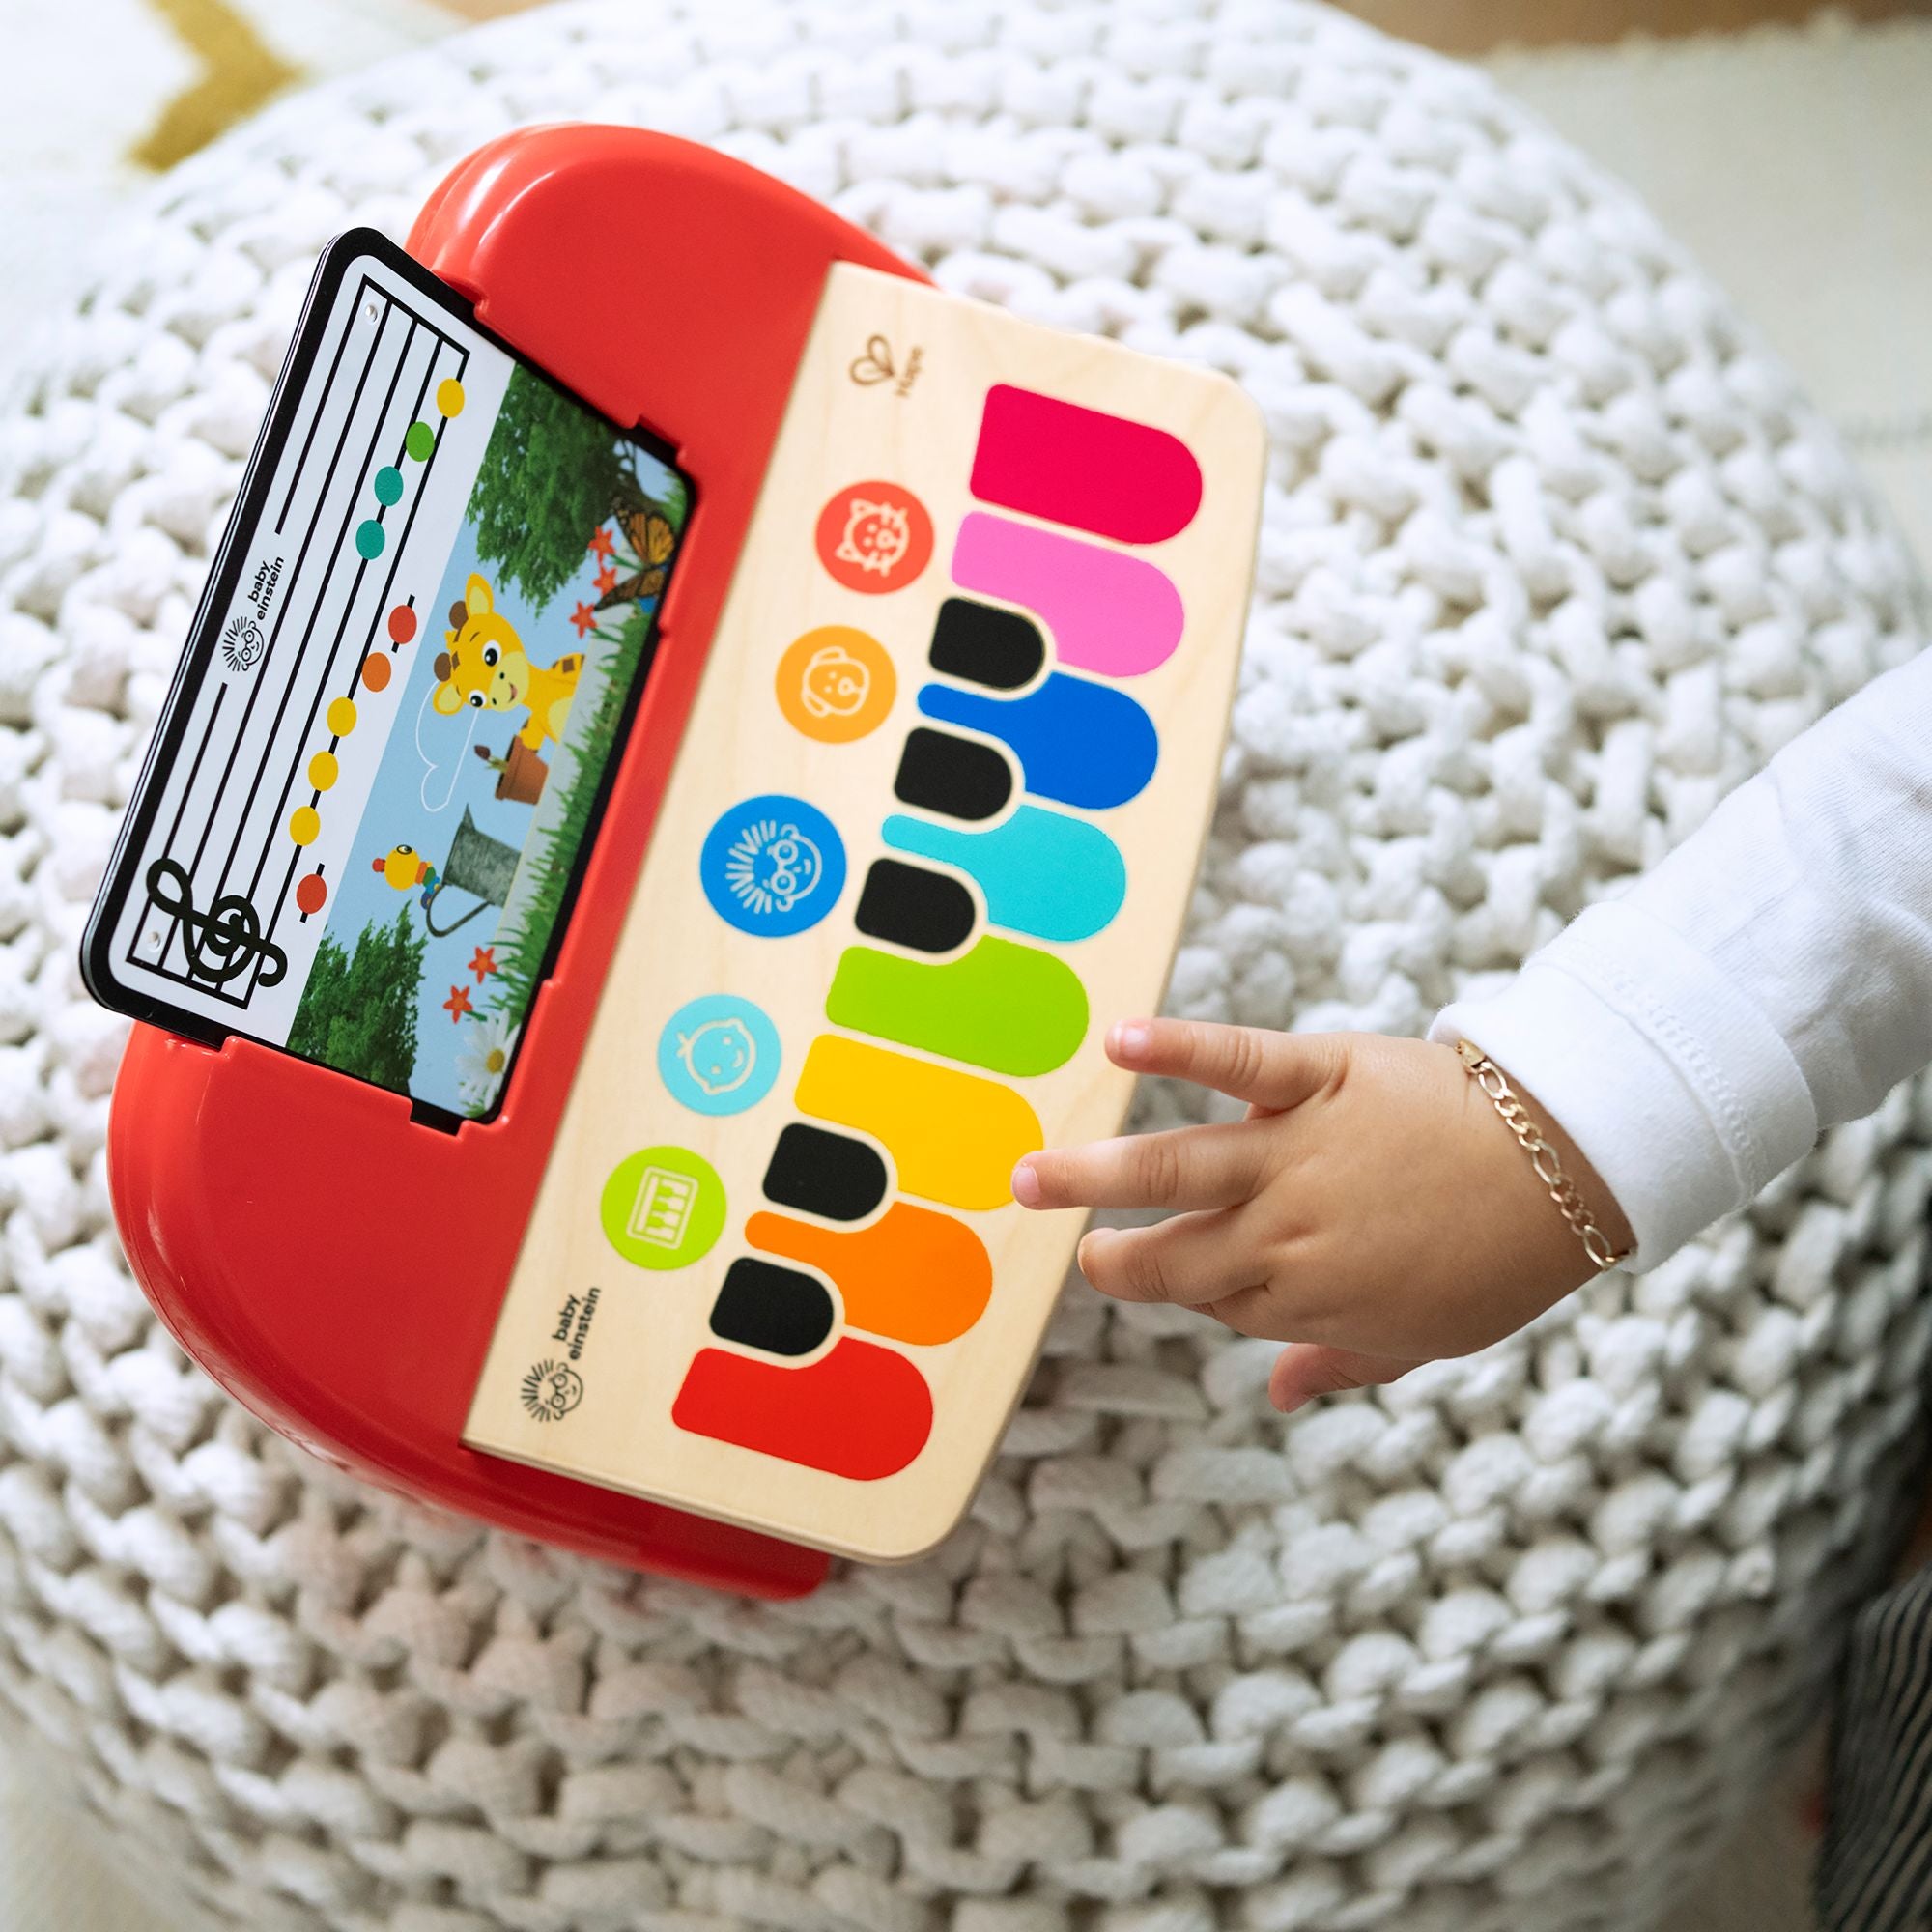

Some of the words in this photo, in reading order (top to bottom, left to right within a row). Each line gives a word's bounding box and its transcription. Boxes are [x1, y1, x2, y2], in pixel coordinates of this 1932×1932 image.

[247, 560, 270, 603] baby
[257, 556, 285, 620] einstein
[552, 1293, 581, 1341] baby
[567, 1286, 601, 1360] einstein
